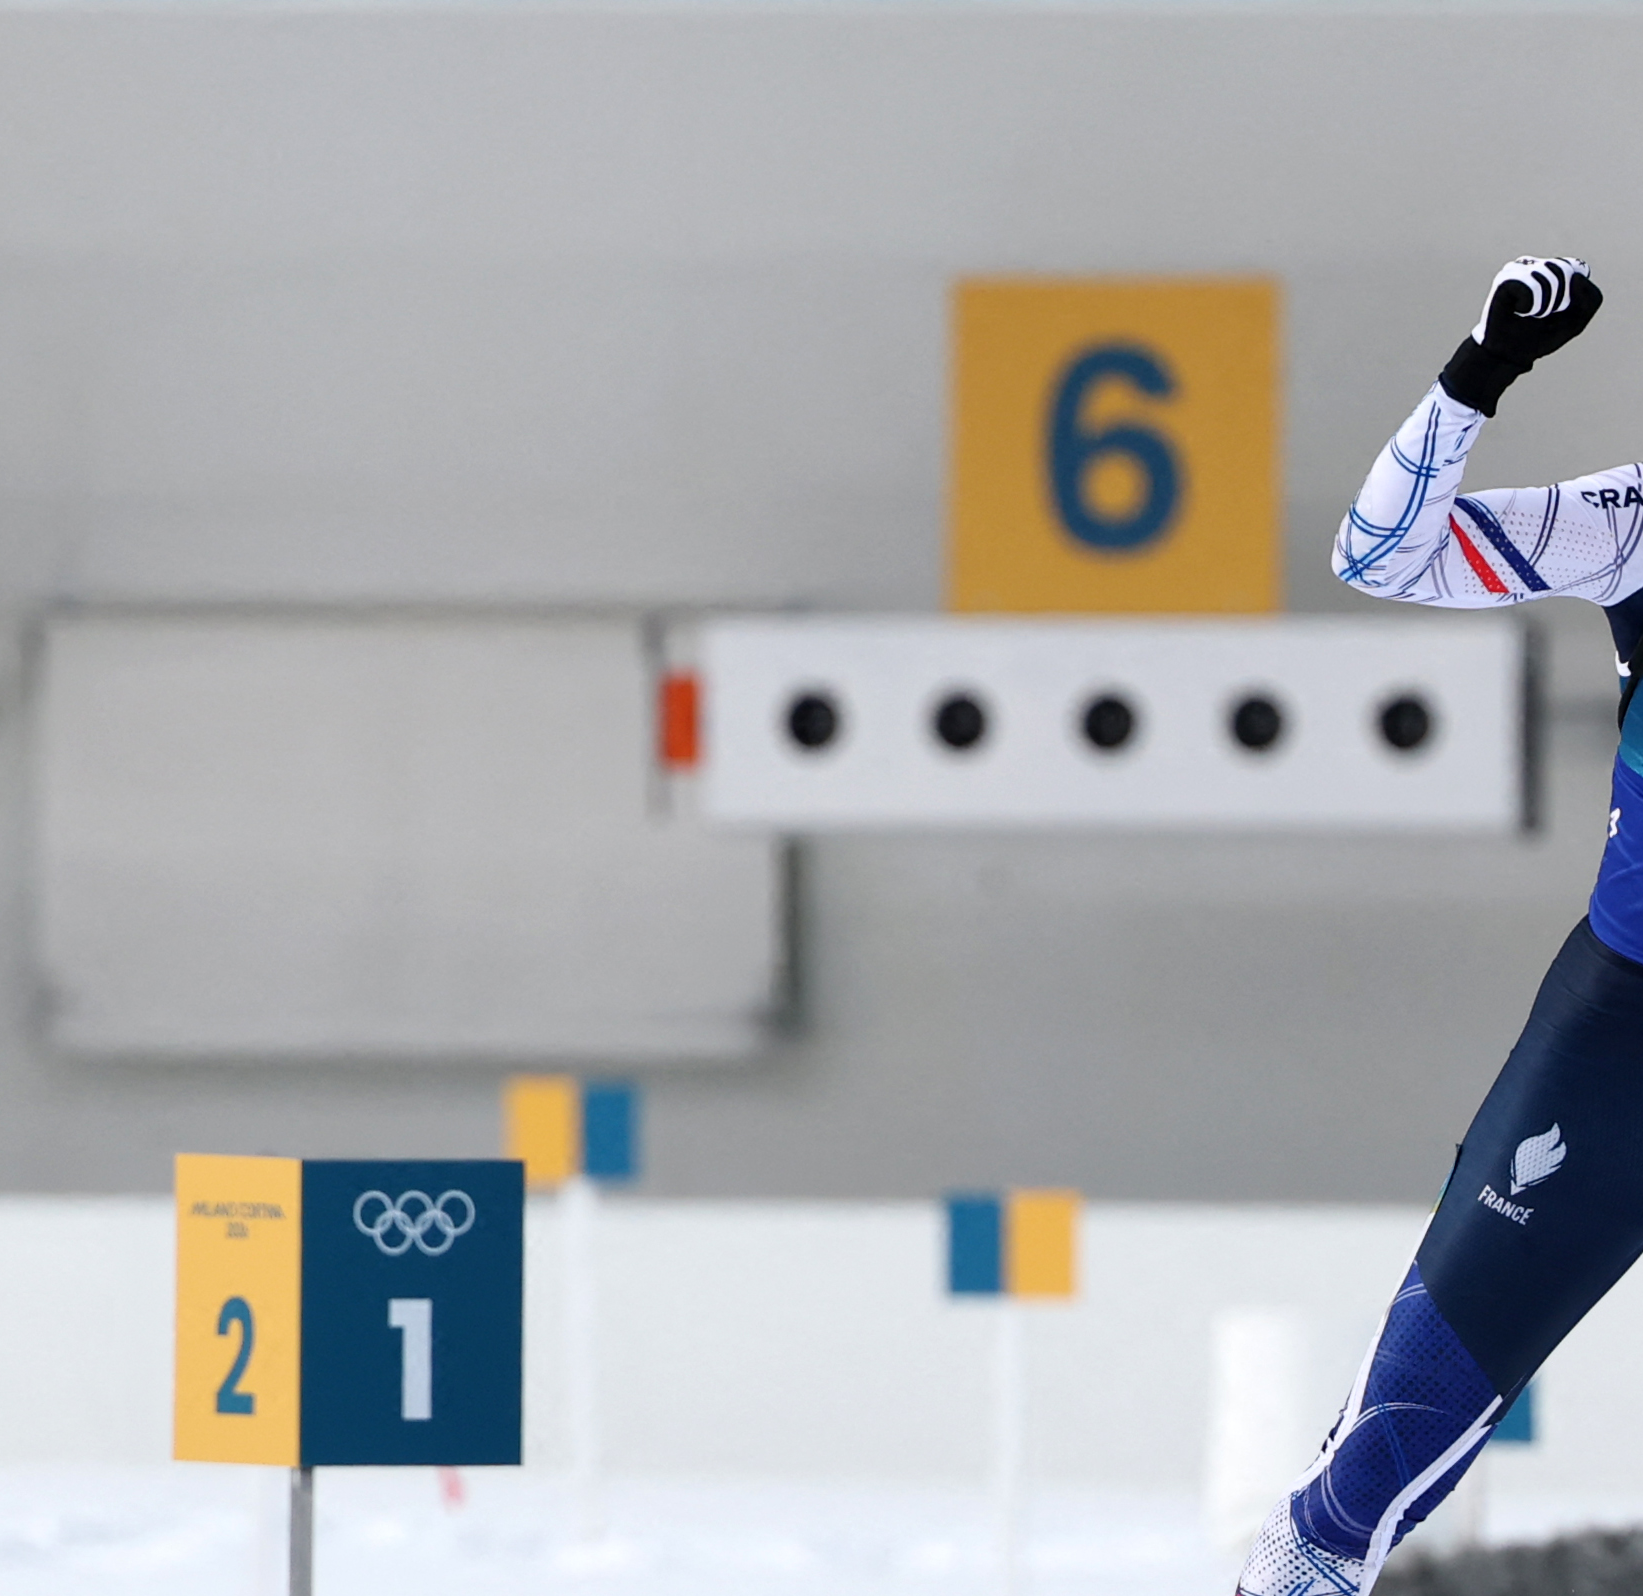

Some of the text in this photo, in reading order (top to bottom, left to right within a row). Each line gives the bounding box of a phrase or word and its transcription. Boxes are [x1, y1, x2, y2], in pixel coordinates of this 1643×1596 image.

[1045, 342, 1186, 557] 6
[1477, 1184, 1535, 1227] FRANCE
[215, 1295, 256, 1415] 2
[388, 1298, 432, 1421] 1
